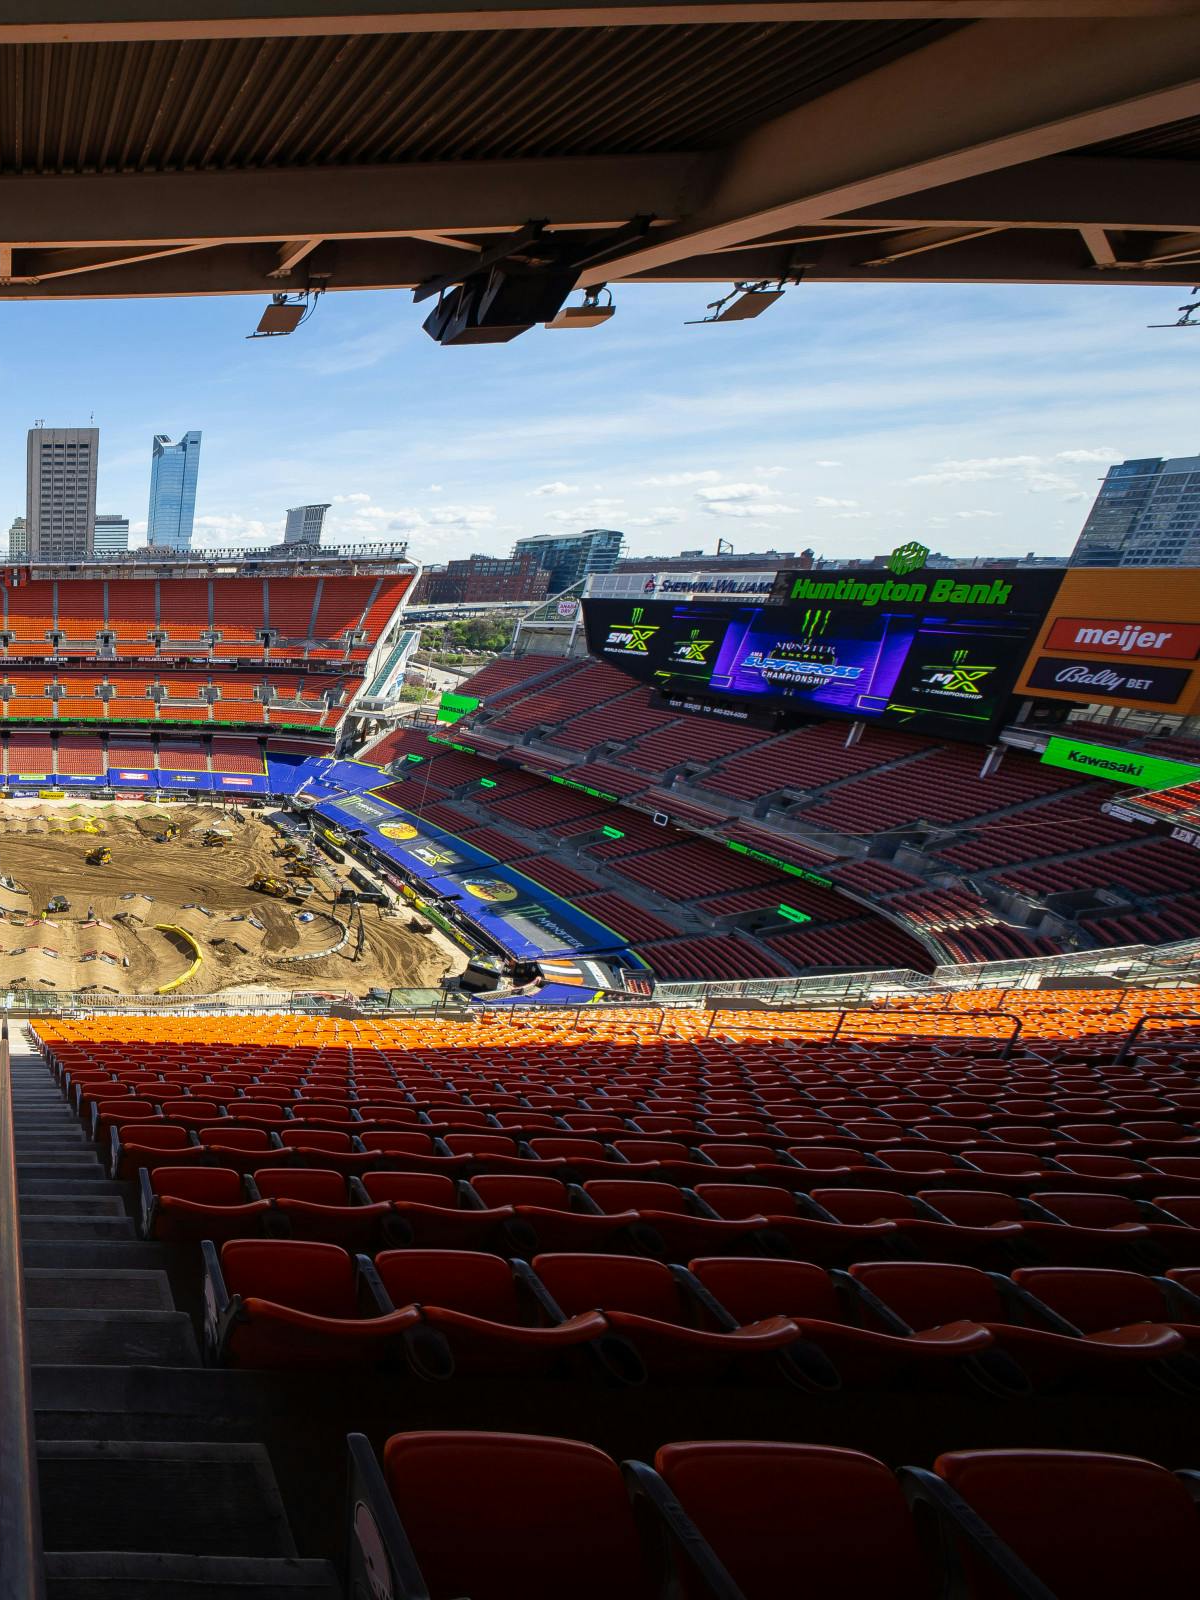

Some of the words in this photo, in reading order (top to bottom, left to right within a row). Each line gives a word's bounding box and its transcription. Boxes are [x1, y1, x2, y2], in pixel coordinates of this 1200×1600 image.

[790, 578, 927, 607] Huntington
[929, 579, 1013, 606] Bank
[606, 630, 655, 651] SMX
[1074, 625, 1172, 652] meijer
[761, 671, 830, 685] CHAMPIONSHIP
[921, 670, 988, 693] MX
[1055, 666, 1126, 692] Bally
[1126, 678, 1153, 690] BET
[930, 689, 983, 700] CHAMPIONSHIP
[439, 704, 467, 717] awasaki
[1067, 750, 1145, 777] Kawasaki
